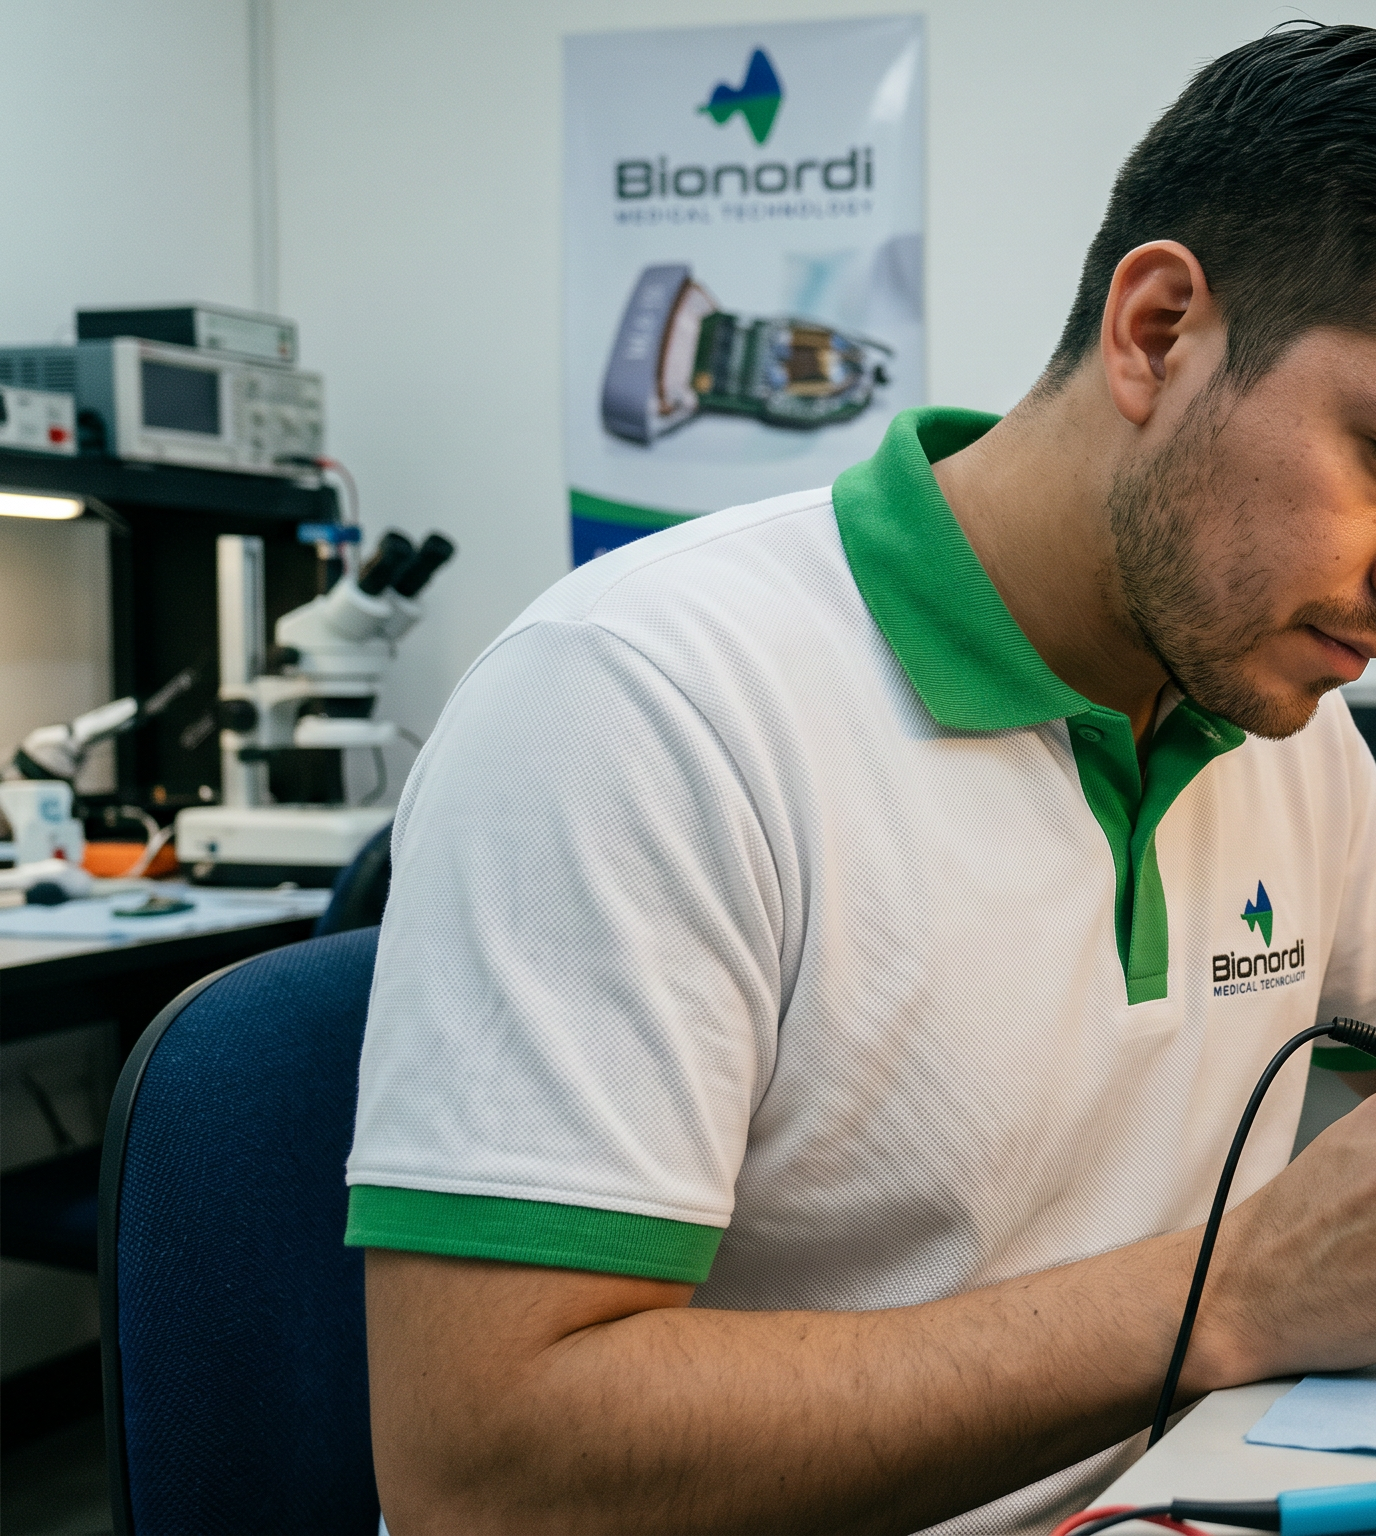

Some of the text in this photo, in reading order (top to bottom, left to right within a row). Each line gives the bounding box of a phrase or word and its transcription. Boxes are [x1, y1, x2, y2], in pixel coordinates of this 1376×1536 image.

[617, 147, 872, 200] Bionordi
[616, 201, 872, 225] MEDICAL TECHNOLOGY
[1213, 939, 1305, 982] Bionordi
[1214, 982, 1257, 997] MEDICAL
